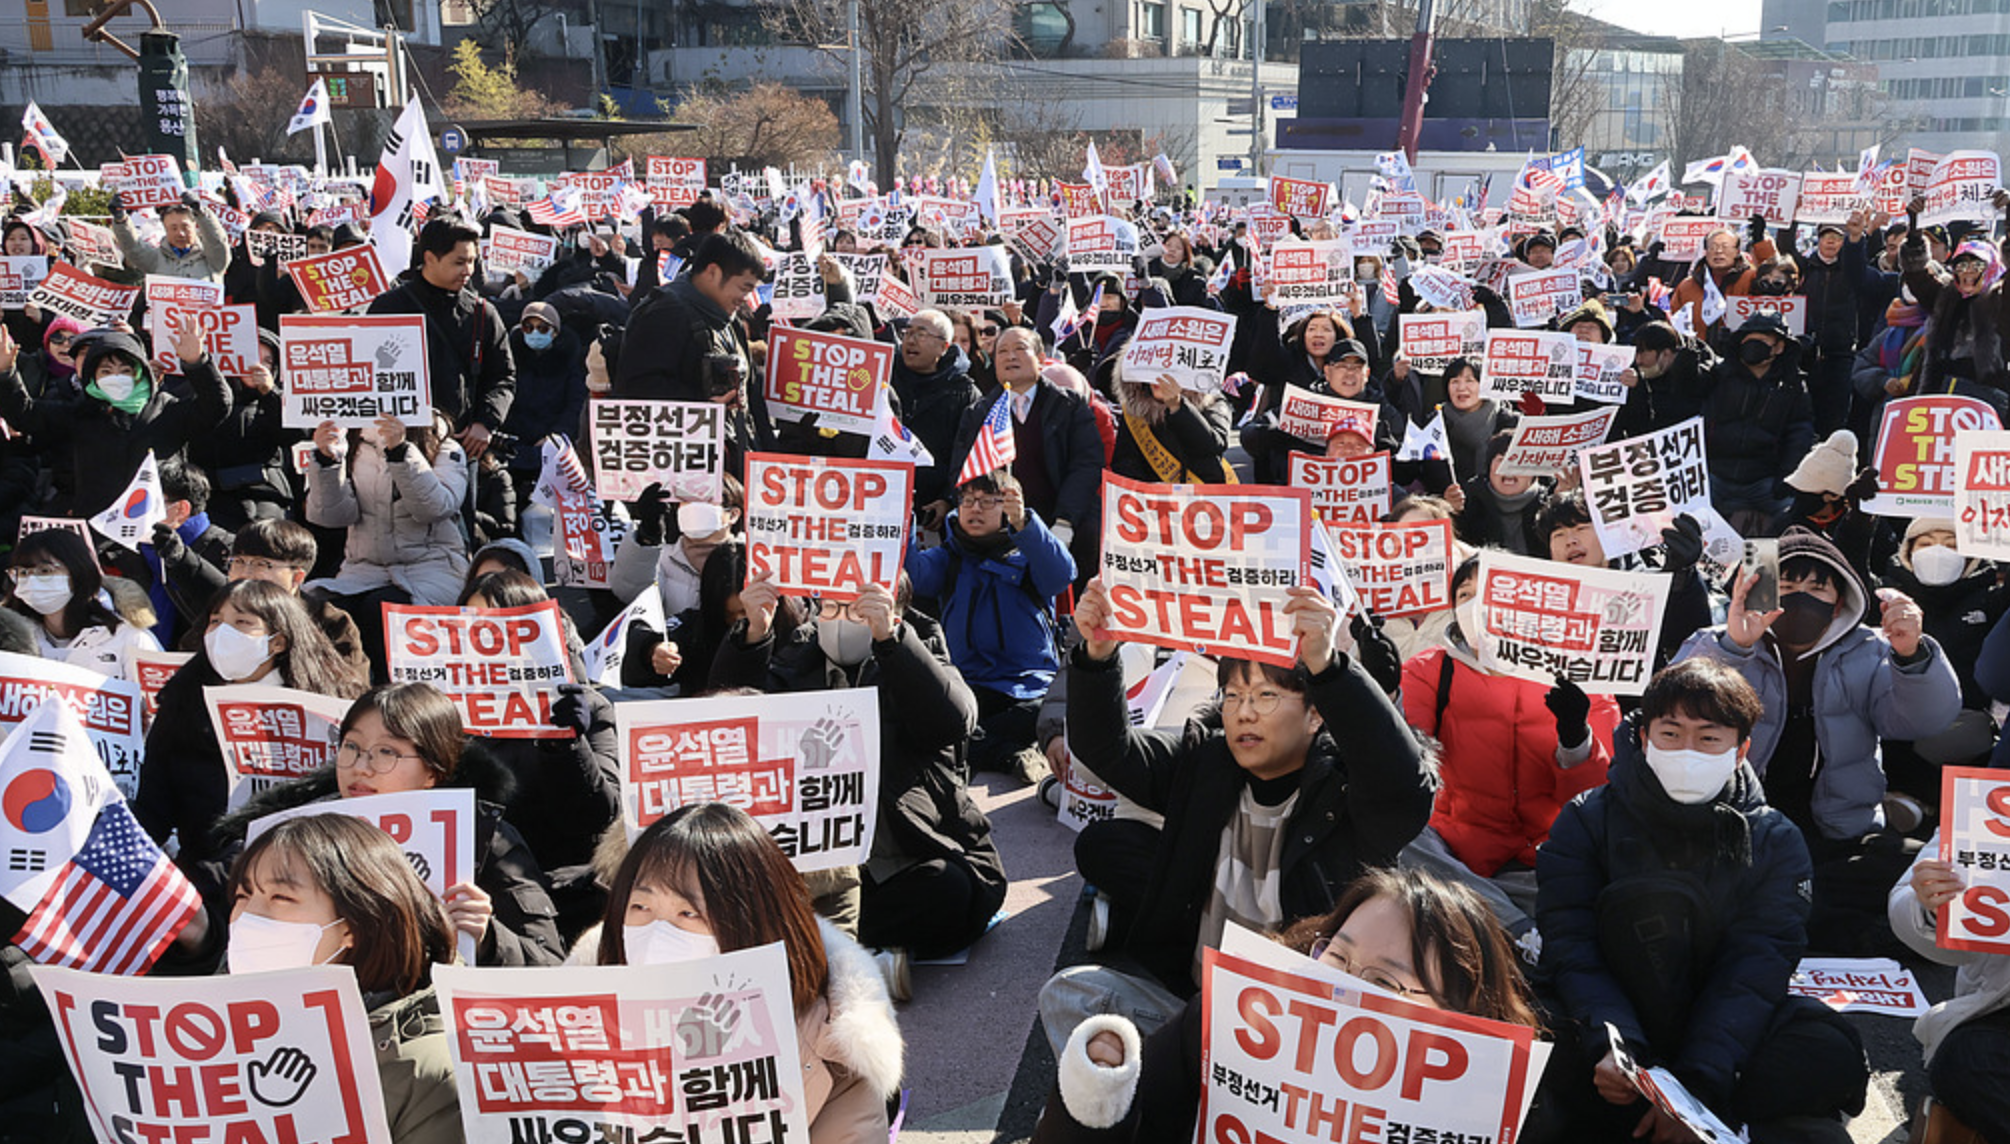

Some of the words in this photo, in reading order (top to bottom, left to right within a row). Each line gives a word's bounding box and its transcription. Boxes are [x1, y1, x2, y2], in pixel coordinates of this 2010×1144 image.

[125, 160, 169, 177] STOP
[136, 178, 160, 188] THE
[653, 161, 696, 175] STOP
[1106, 170, 1131, 180] TOP
[1738, 174, 1787, 190] STOP
[1951, 159, 1997, 177] 소원은
[121, 187, 182, 206] STEAL
[573, 178, 614, 190] STOP
[664, 180, 685, 190] THE
[1743, 190, 1779, 206] THE
[1729, 204, 1786, 221] STEAL
[305, 257, 358, 282] STOP
[316, 271, 354, 295] THE
[317, 287, 376, 311] STEAL
[1142, 321, 1170, 341] 새해
[1169, 319, 1225, 344] 소원은
[161, 355, 253, 380] SAL
[289, 343, 348, 366] 윤석열
[793, 339, 868, 369] STOP
[292, 369, 372, 391] 대통령과
[376, 372, 417, 393] 함께
[797, 361, 849, 388] THE
[1491, 378, 1571, 397] 싸우겠습니다
[302, 396, 419, 418] 싸우겠습니다
[784, 382, 864, 414] STEAL
[1289, 402, 1319, 423] 새해
[596, 404, 718, 440] 부정선거
[1523, 427, 1564, 449] 새해
[1563, 416, 1610, 444] 소원은
[597, 439, 719, 474] 검증하라
[1507, 448, 1567, 473] 이재명
[1590, 423, 1702, 485] 부정선거
[1912, 435, 1956, 463] TH
[1302, 462, 1379, 485] STOP
[1894, 463, 1955, 492] STE
[1973, 455, 2010, 486] 새
[762, 466, 888, 511] STOP
[1326, 488, 1358, 502] THE
[1594, 463, 1706, 525] 검증하라
[562, 490, 593, 560] 부정선
[1117, 494, 1274, 550] STOP
[1314, 504, 1382, 523] TEAL
[788, 514, 848, 543] THE
[849, 521, 901, 545] 검증하라
[1339, 529, 1428, 560] STOP
[752, 542, 892, 588] STEAL
[1105, 552, 1157, 575] 부정선거
[1157, 554, 1227, 588] THE
[1227, 567, 1296, 587] 검증하라
[1360, 565, 1403, 583] THE
[1491, 574, 1571, 611] 윤석열
[1110, 585, 1292, 651] STEAL
[1490, 609, 1596, 646] 대통령과
[405, 618, 541, 656] STOP
[1599, 629, 1649, 653] 함께
[446, 663, 509, 686] THE
[509, 664, 565, 681] 검증하라
[1497, 639, 1645, 683] 싸우겠습니다
[226, 707, 303, 739] 윤석열
[235, 740, 323, 775] 대통령과
[637, 726, 751, 773] 윤석열
[641, 766, 790, 816] 대통령과
[799, 771, 865, 812] 함께
[768, 814, 865, 859] 습니다
[92, 999, 281, 1061] STOP
[464, 1005, 611, 1053] 윤석열
[1235, 986, 1470, 1102] STOP
[112, 1061, 249, 1119] THE
[475, 1059, 666, 1106] 대통령과
[679, 1056, 779, 1113] 함께
[1212, 1062, 1281, 1113] 부정선거
[1280, 1082, 1388, 1144] THE
